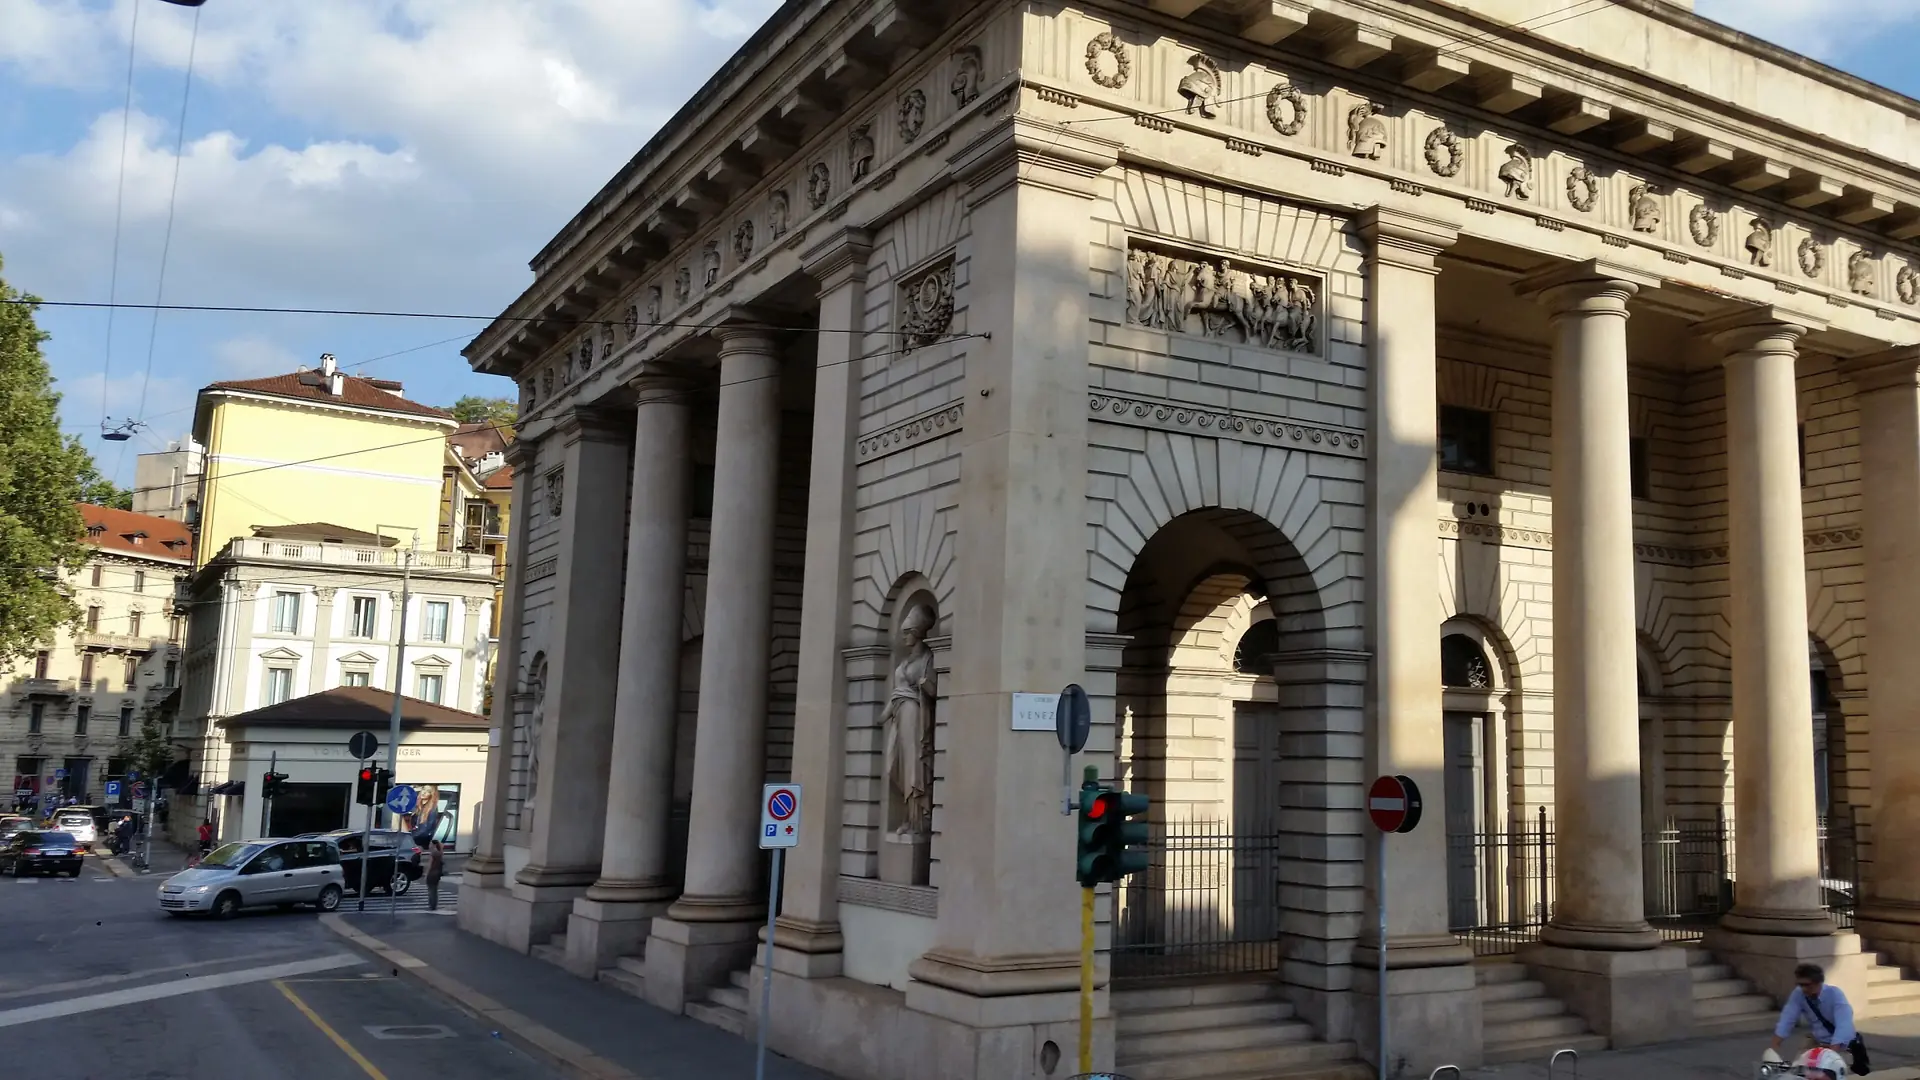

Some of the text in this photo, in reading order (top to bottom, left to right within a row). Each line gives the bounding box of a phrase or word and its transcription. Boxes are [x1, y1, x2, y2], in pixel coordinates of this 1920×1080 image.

[1019, 711, 1055, 720] VENEZ
[108, 783, 117, 794] P
[767, 825, 775, 836] P
